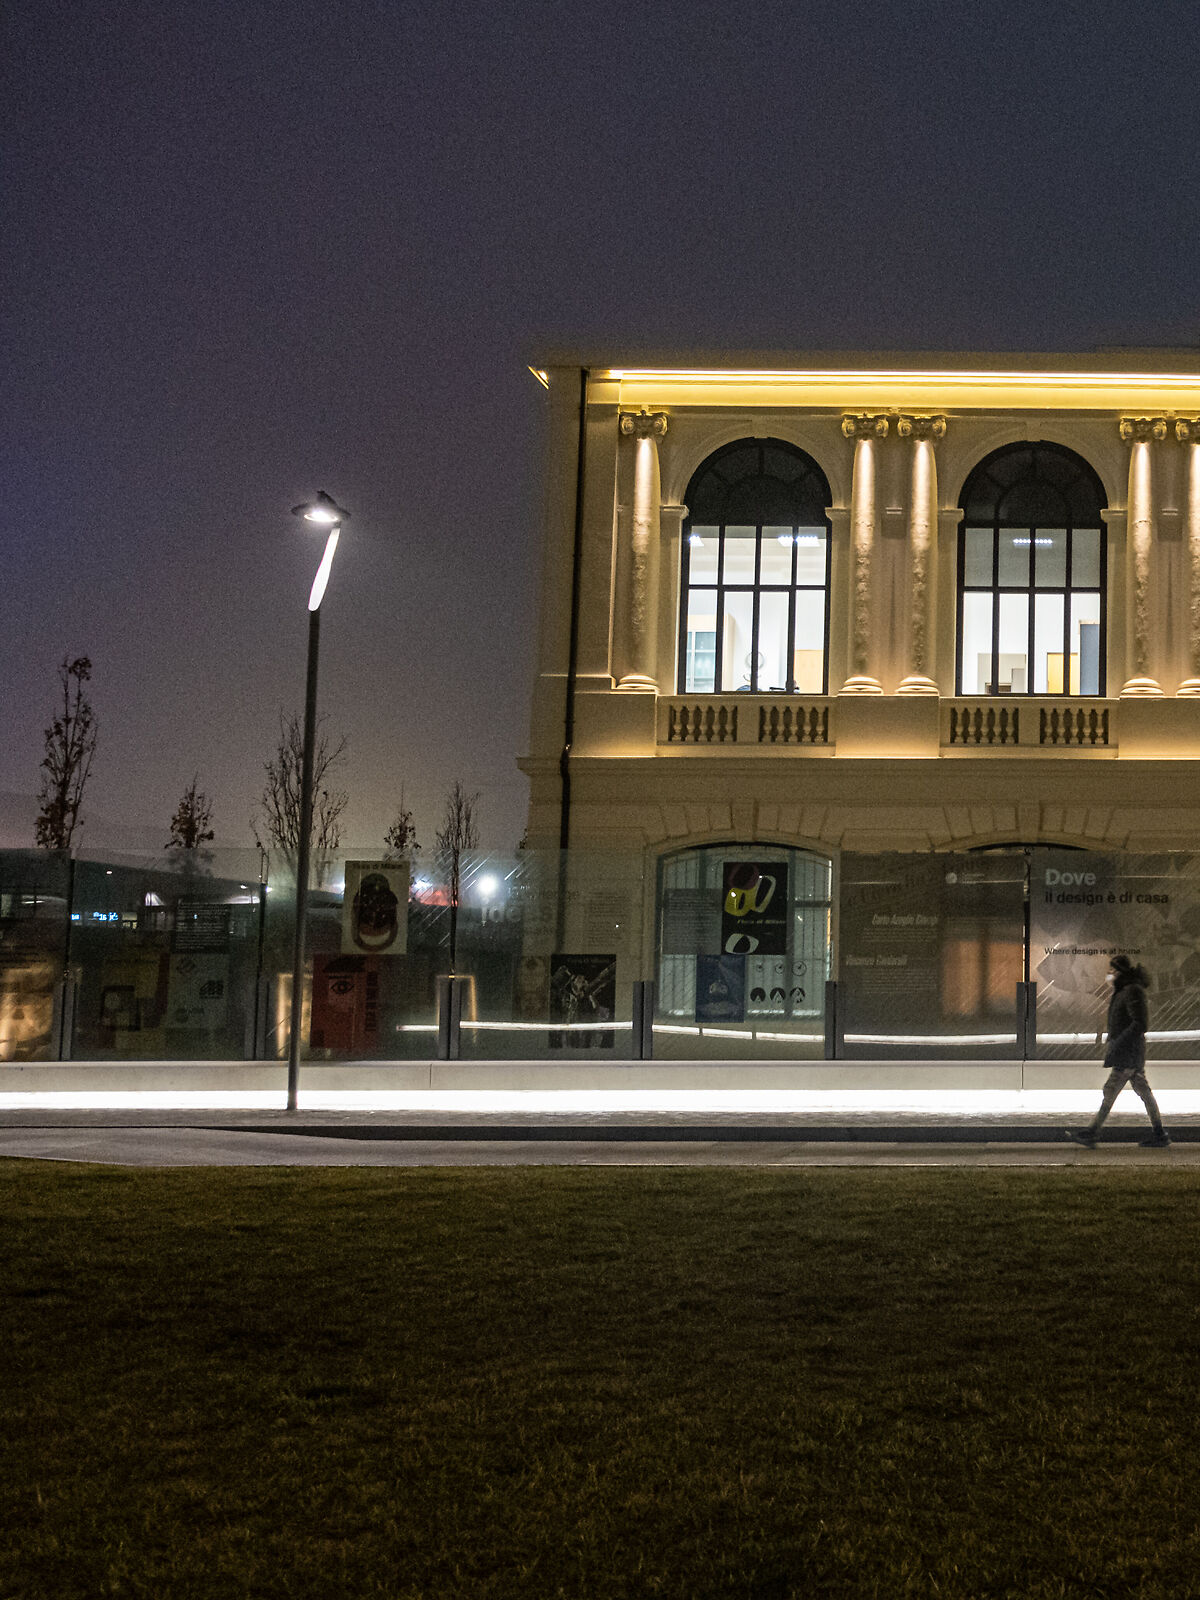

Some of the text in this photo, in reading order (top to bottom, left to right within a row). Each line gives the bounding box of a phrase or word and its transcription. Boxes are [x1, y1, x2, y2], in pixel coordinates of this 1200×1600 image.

[1045, 868, 1097, 886] Dove
[1044, 891, 1169, 906] il design è di casa
[1045, 947, 1141, 957] Where design is at home
